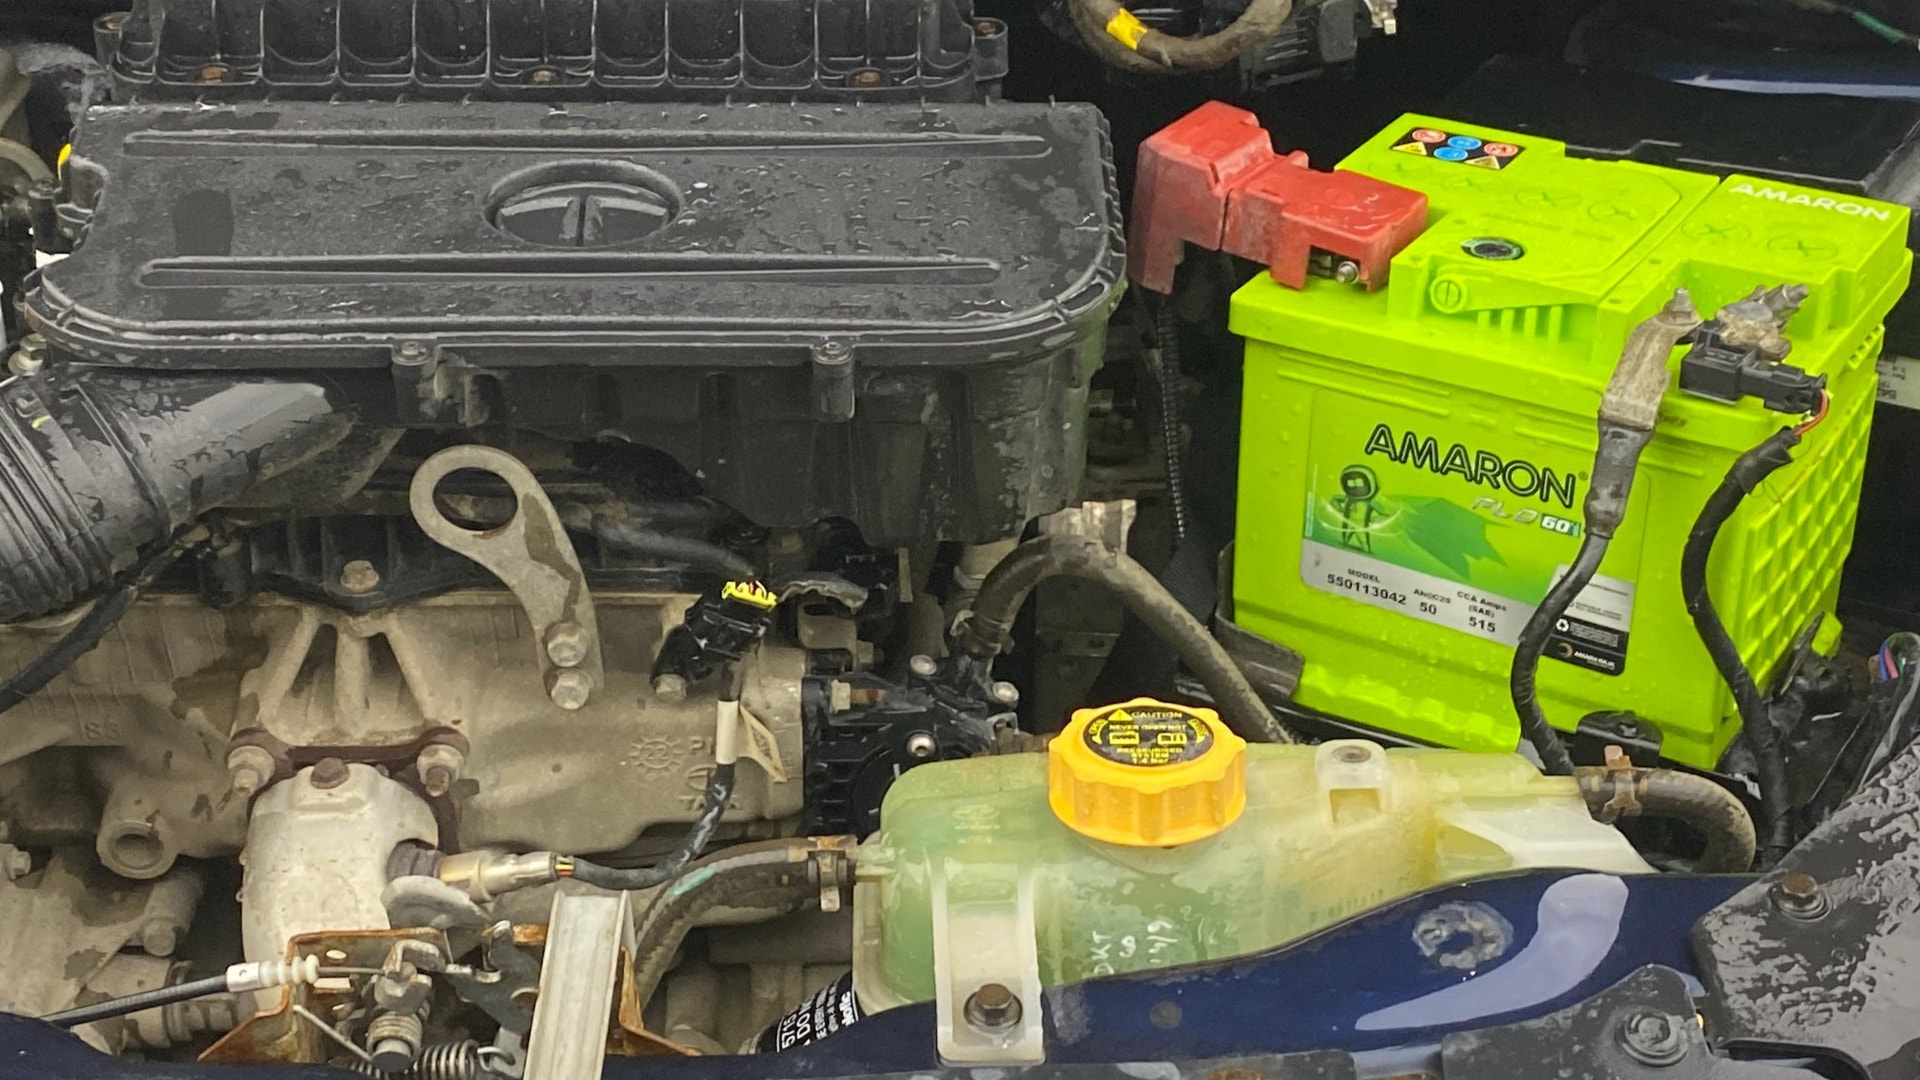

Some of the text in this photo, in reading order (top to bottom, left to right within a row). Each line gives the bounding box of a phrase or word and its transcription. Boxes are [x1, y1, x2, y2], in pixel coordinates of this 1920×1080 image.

[1729, 184, 1890, 221] AMARON
[1365, 424, 1577, 508] AMARON
[1347, 568, 1381, 583] MODEL
[1327, 573, 1407, 606] 550113042
[1457, 591, 1477, 602] CCA
[1419, 601, 1438, 615] 50
[1468, 616, 1496, 633] 515
